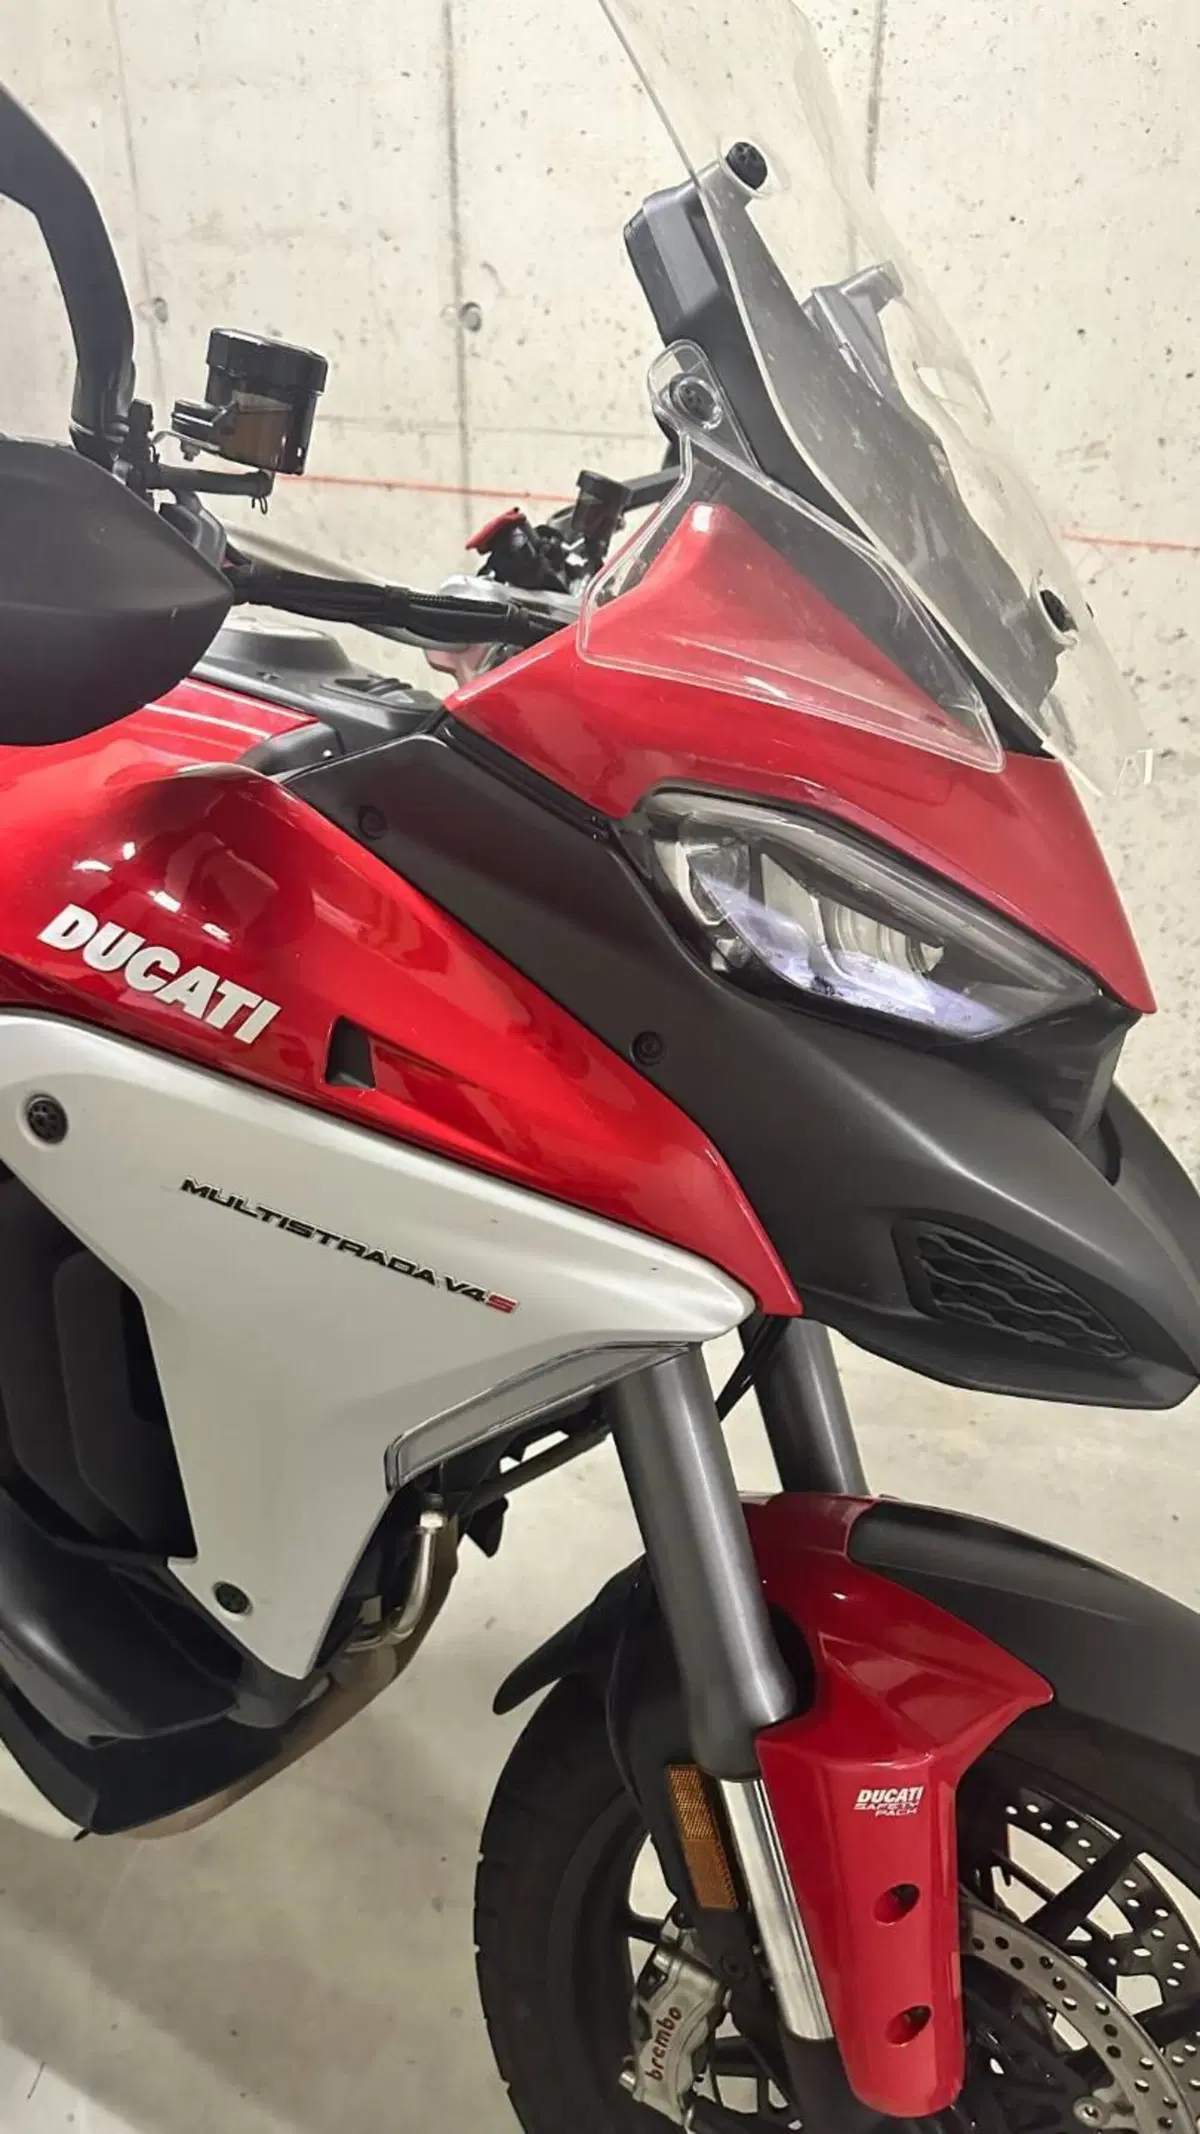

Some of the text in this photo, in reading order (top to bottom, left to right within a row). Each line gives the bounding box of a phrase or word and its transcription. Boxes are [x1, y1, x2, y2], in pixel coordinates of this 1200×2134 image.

[36, 904, 281, 1045] DUCATI
[180, 1176, 437, 1287] MULTISTRADA
[854, 1800, 920, 1811] SAFETY
[856, 1786, 924, 1804] DUCATI
[875, 1808, 918, 1817] PACK
[645, 2006, 682, 2081] brembo
